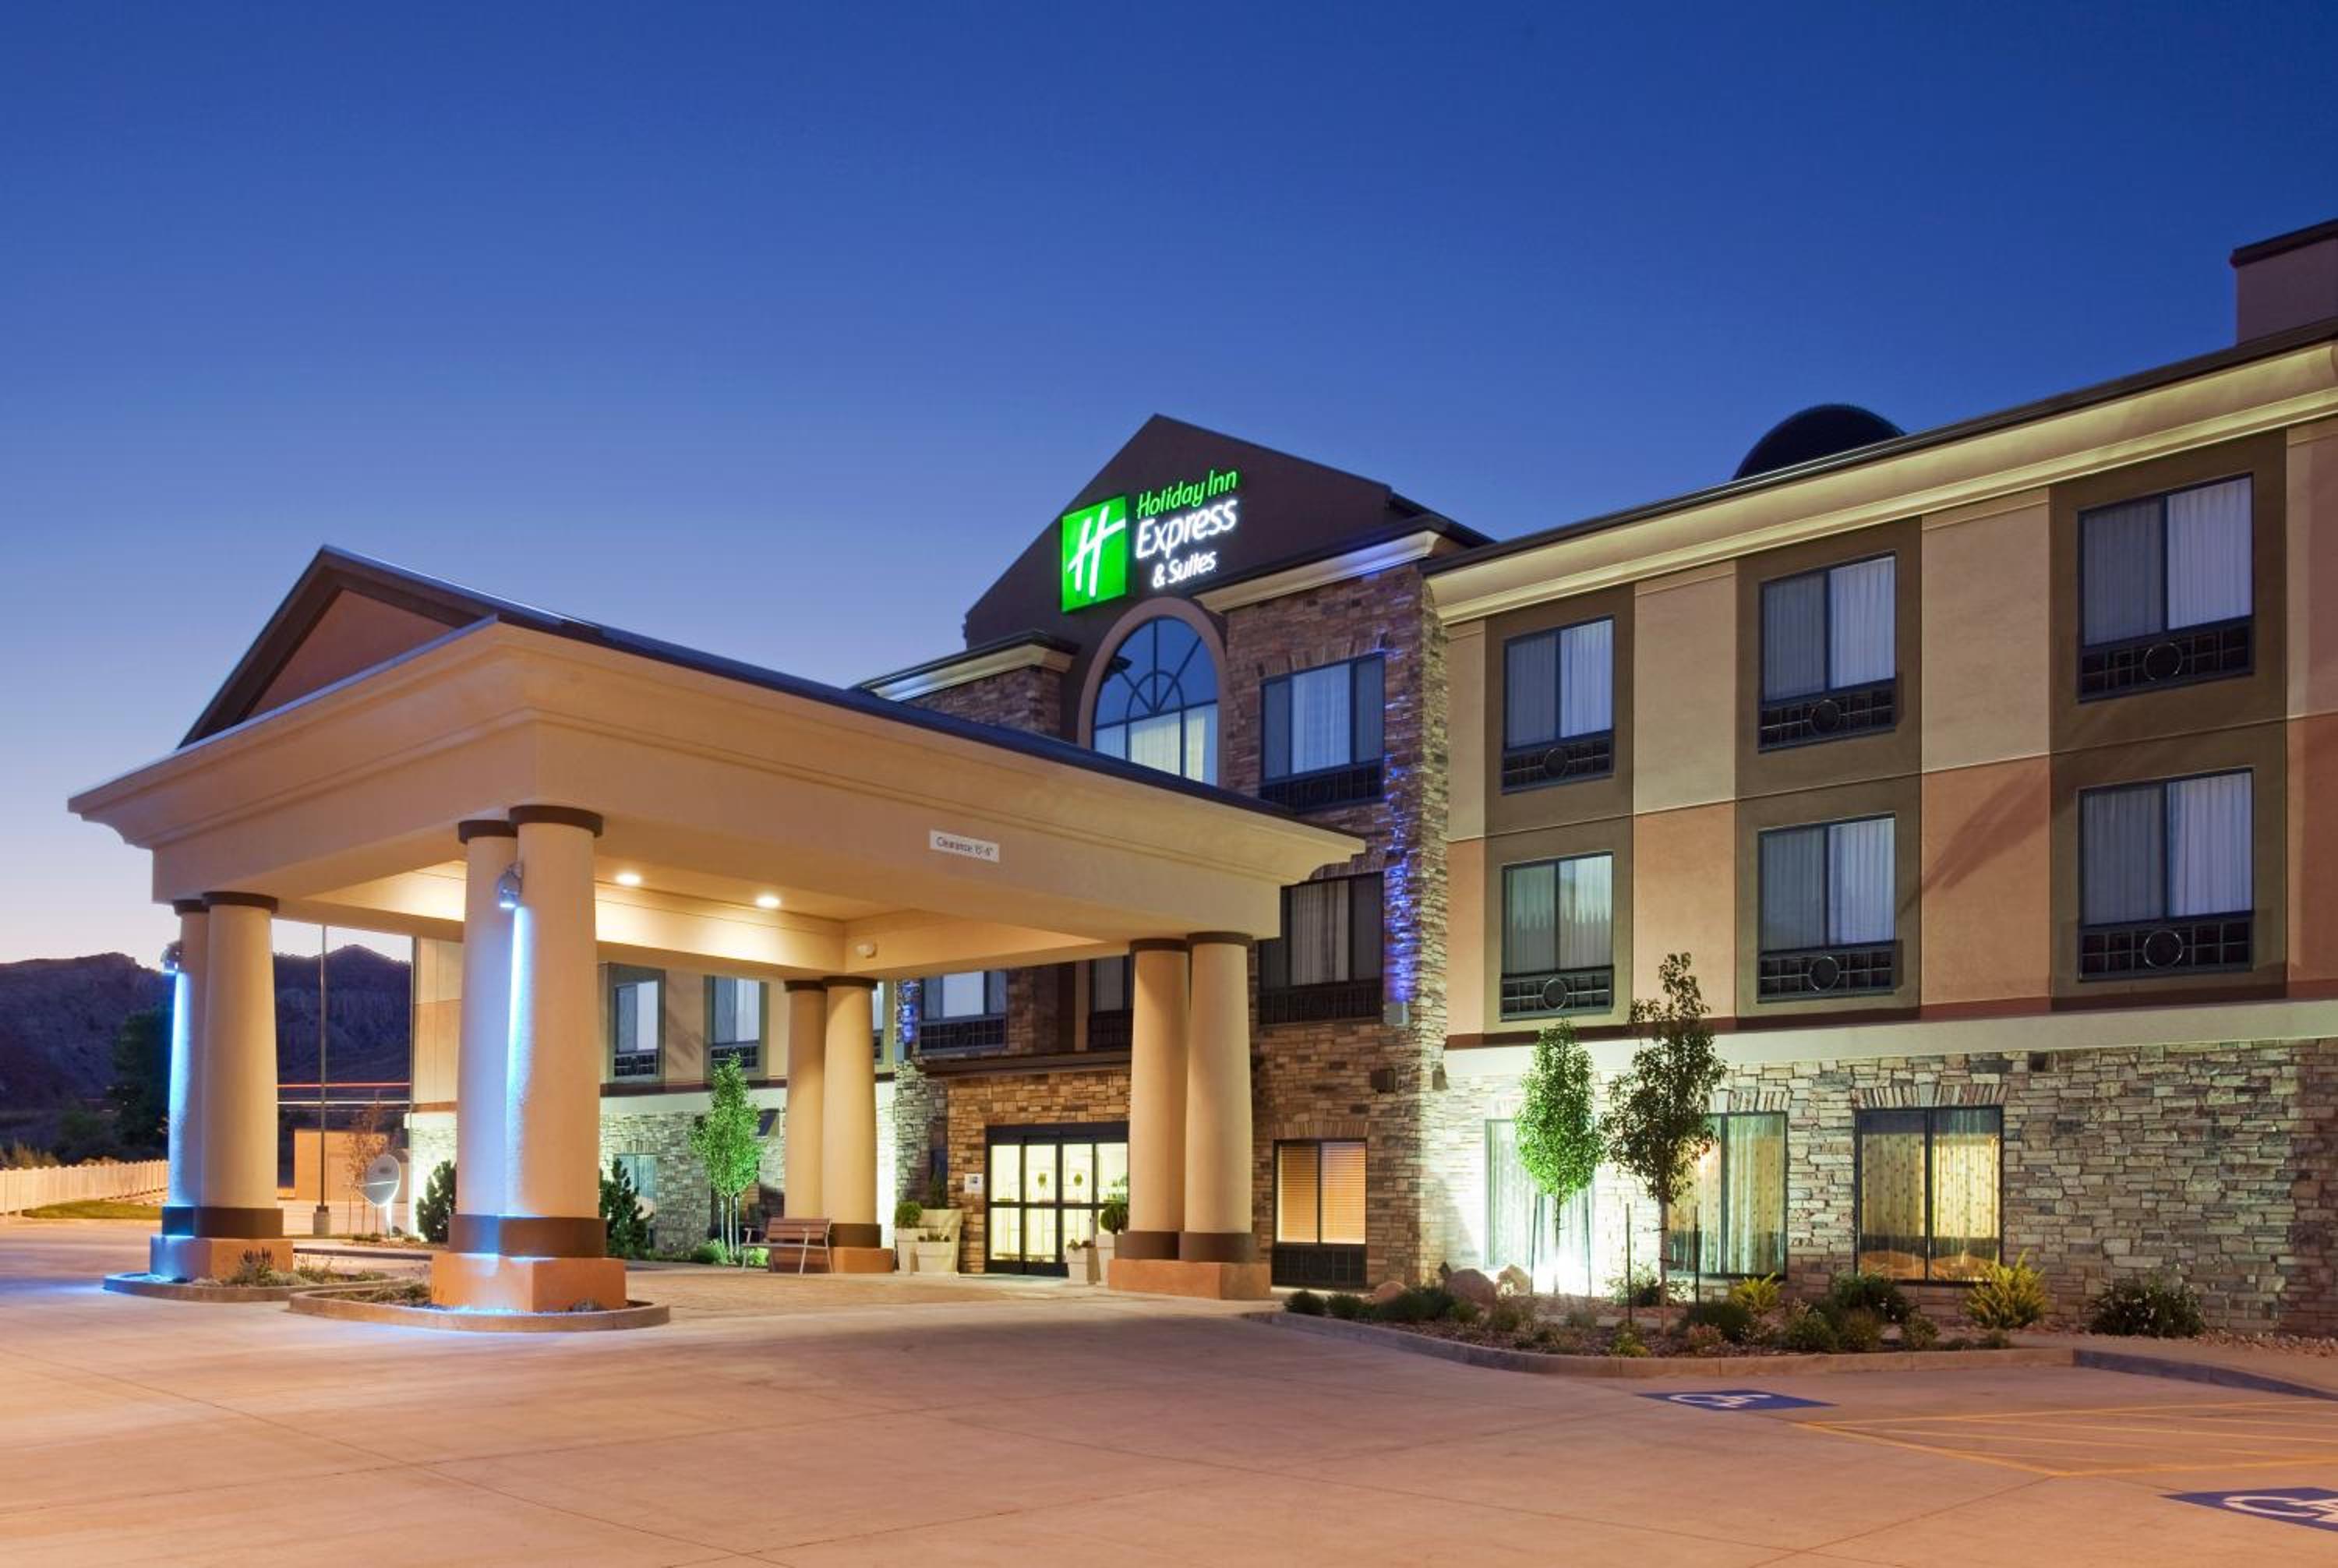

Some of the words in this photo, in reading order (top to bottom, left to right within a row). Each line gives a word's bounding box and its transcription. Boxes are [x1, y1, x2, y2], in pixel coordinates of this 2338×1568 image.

[1136, 480, 1205, 520] Holiday
[1207, 469, 1238, 496] Inn
[1135, 499, 1238, 560] Express
[1152, 563, 1166, 589] &
[1168, 551, 1217, 584] Suites
